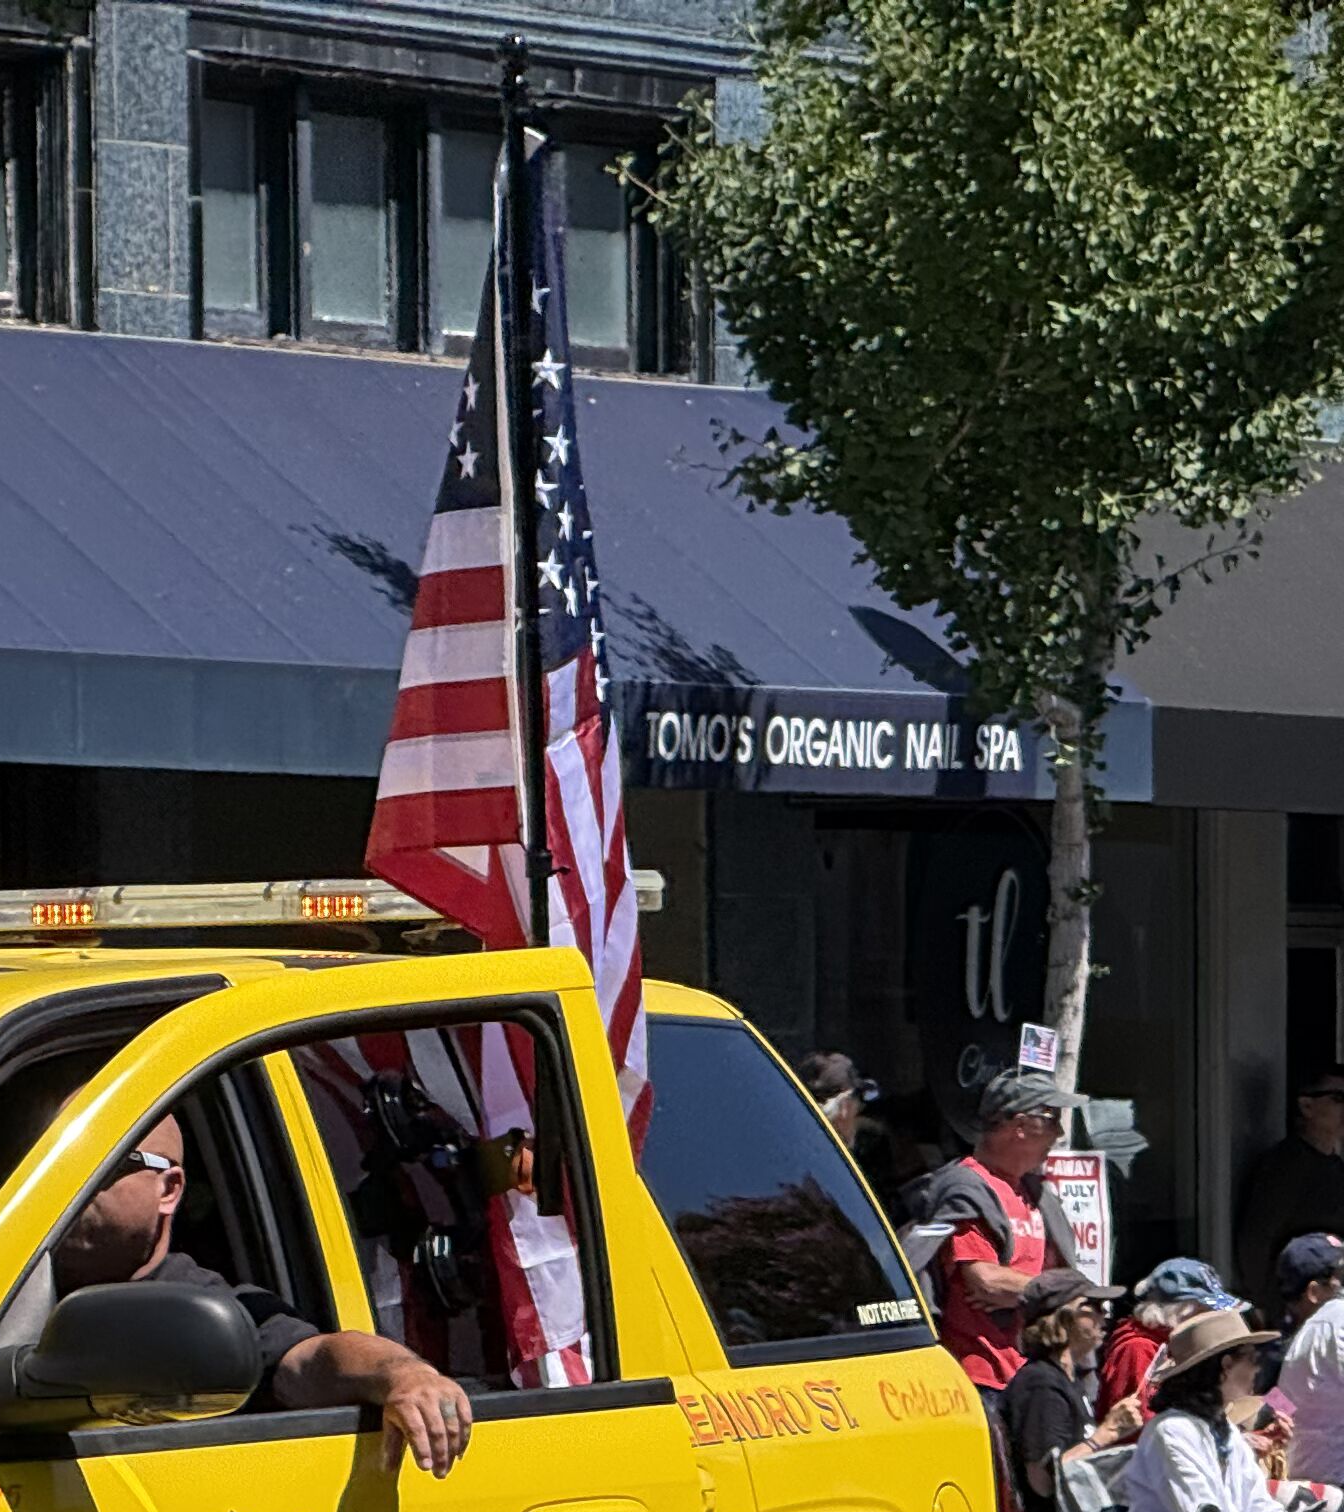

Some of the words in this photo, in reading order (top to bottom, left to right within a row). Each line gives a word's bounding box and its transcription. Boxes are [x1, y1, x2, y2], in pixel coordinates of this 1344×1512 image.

[646, 712, 754, 764] TOMO'S
[765, 715, 894, 769] ORGANIC
[905, 722, 963, 770] NAIL
[974, 724, 1023, 772] SPA
[1062, 1184, 1096, 1198] JULY
[856, 1303, 881, 1326] NOT
[879, 1300, 902, 1323] FOR
[677, 1385, 812, 1448] EANDRO
